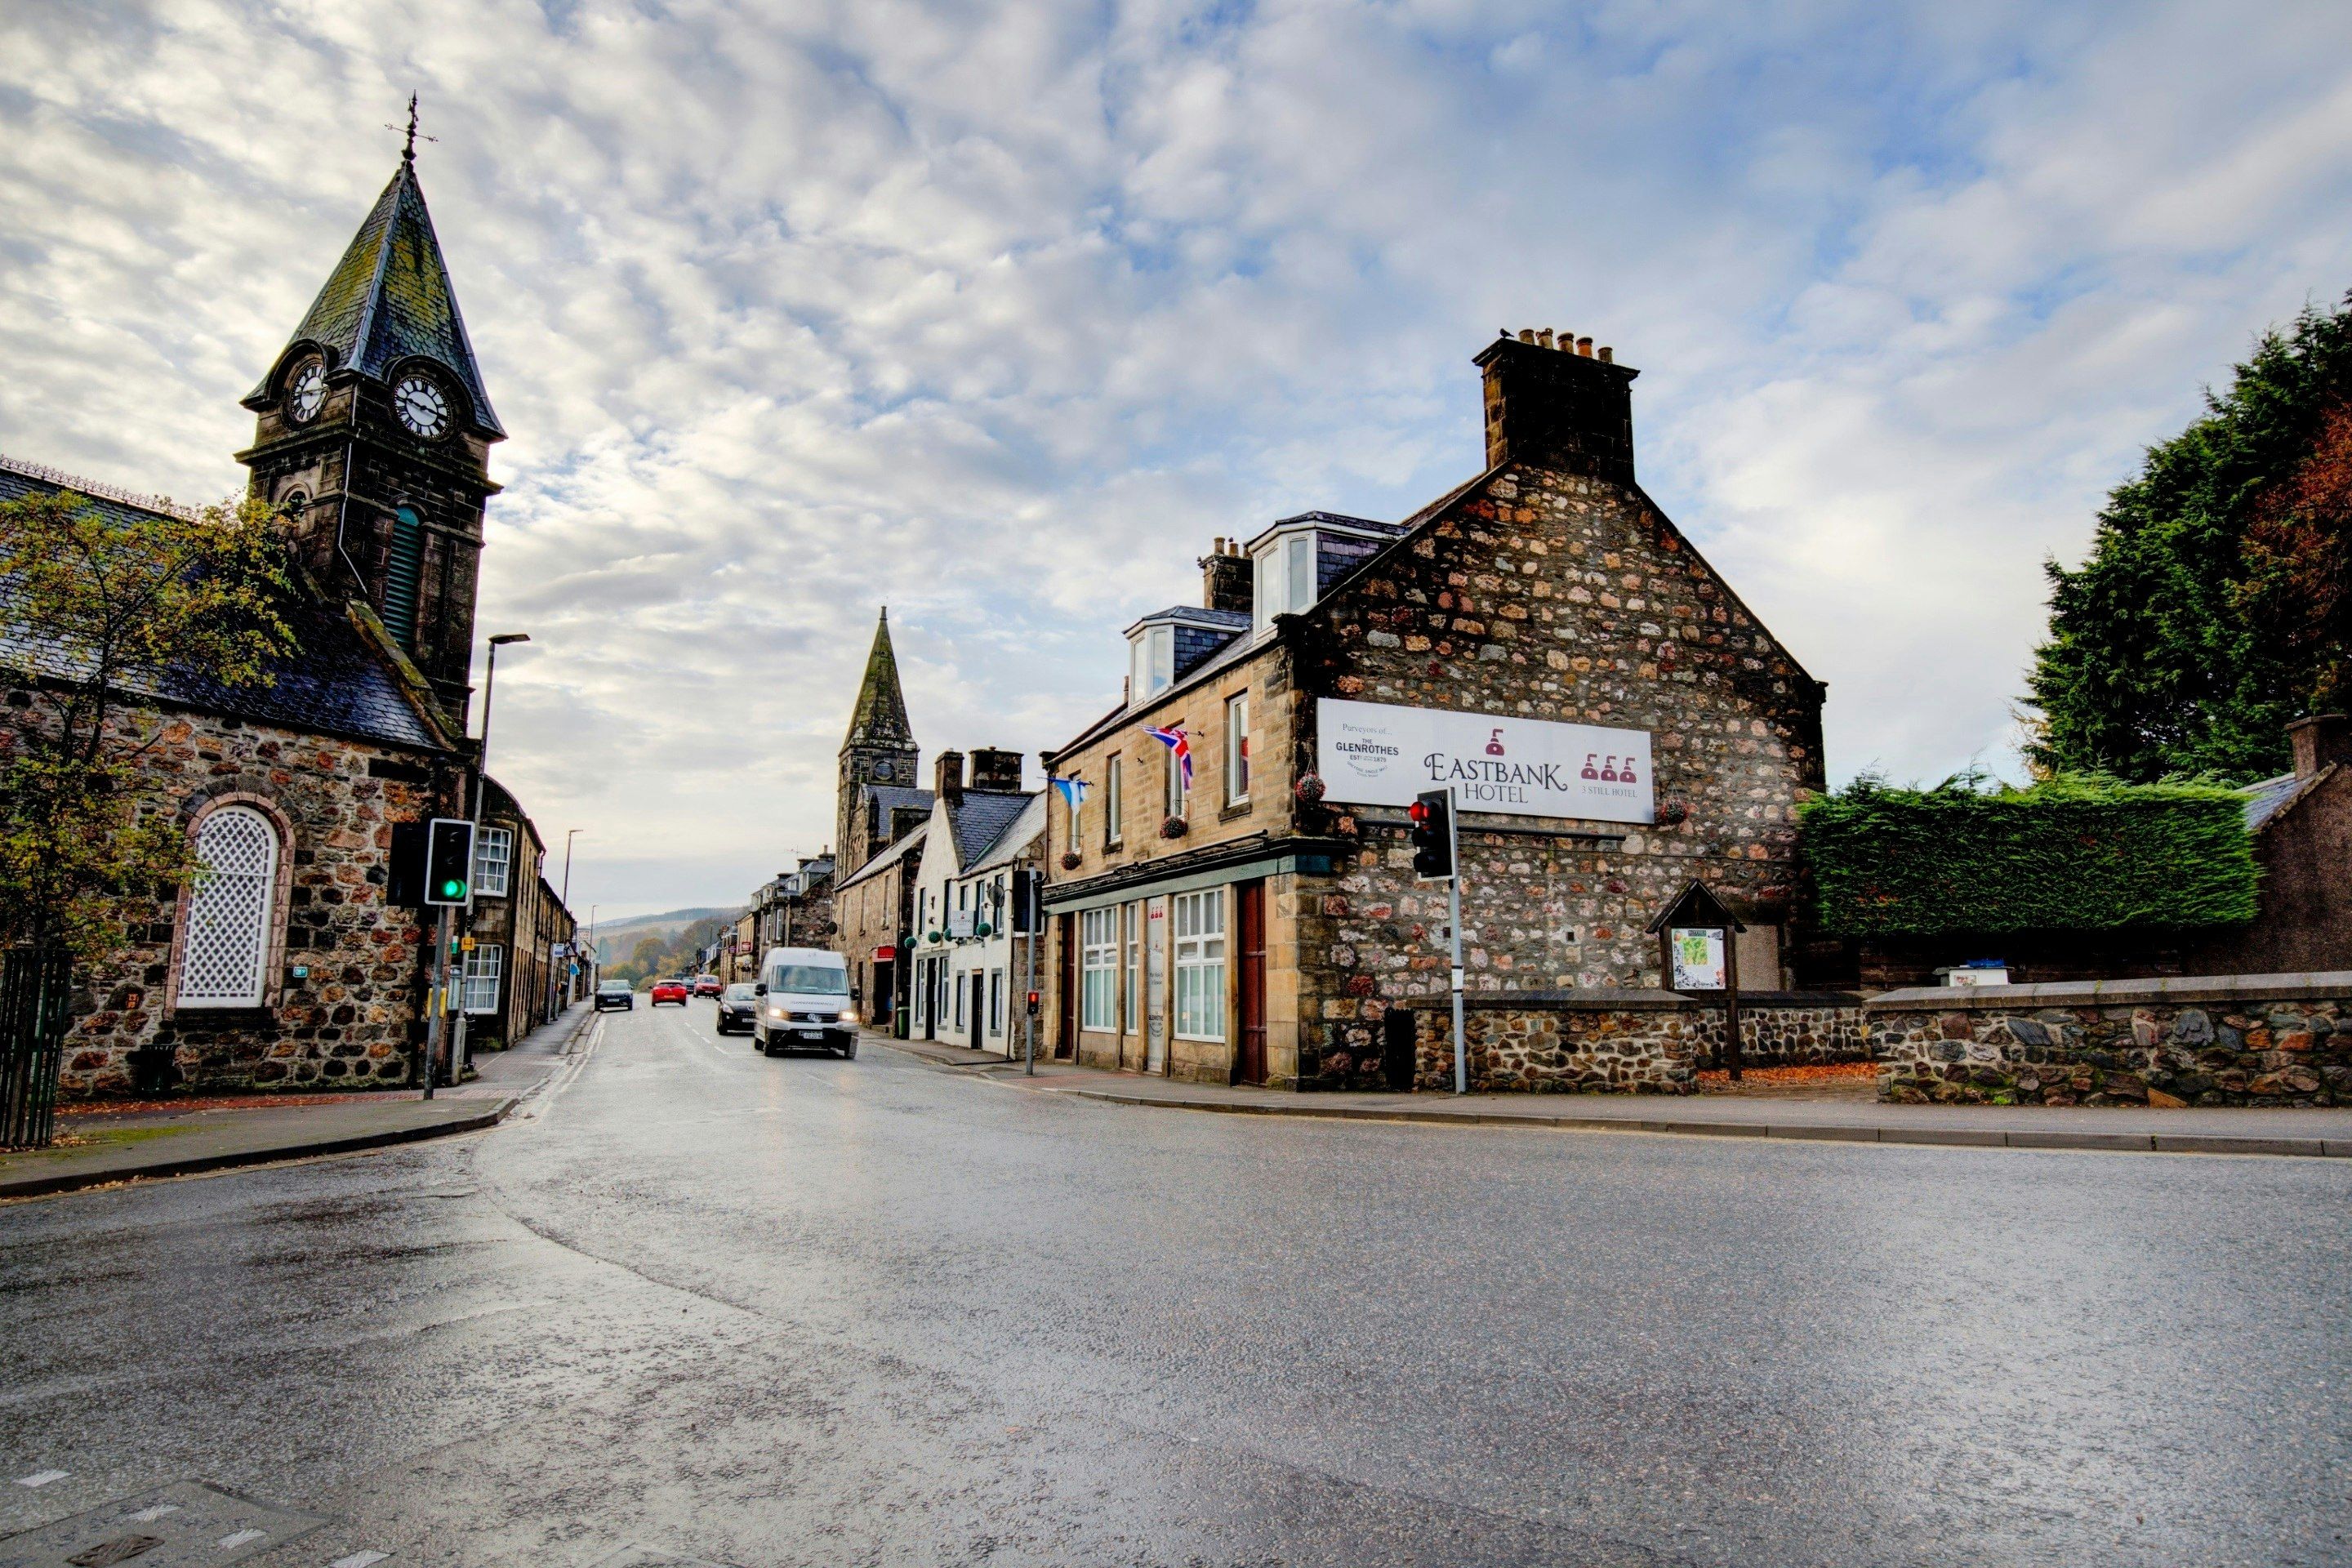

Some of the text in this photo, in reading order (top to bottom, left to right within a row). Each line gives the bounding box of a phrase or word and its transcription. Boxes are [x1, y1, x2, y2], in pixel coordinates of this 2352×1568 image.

[1335, 742, 1399, 755] GLENROTHES
[1423, 753, 1568, 791] EASTBANK
[1465, 782, 1529, 804] HOTEL
[1588, 786, 1610, 795] STILL
[1612, 788, 1638, 798] HOTEL
